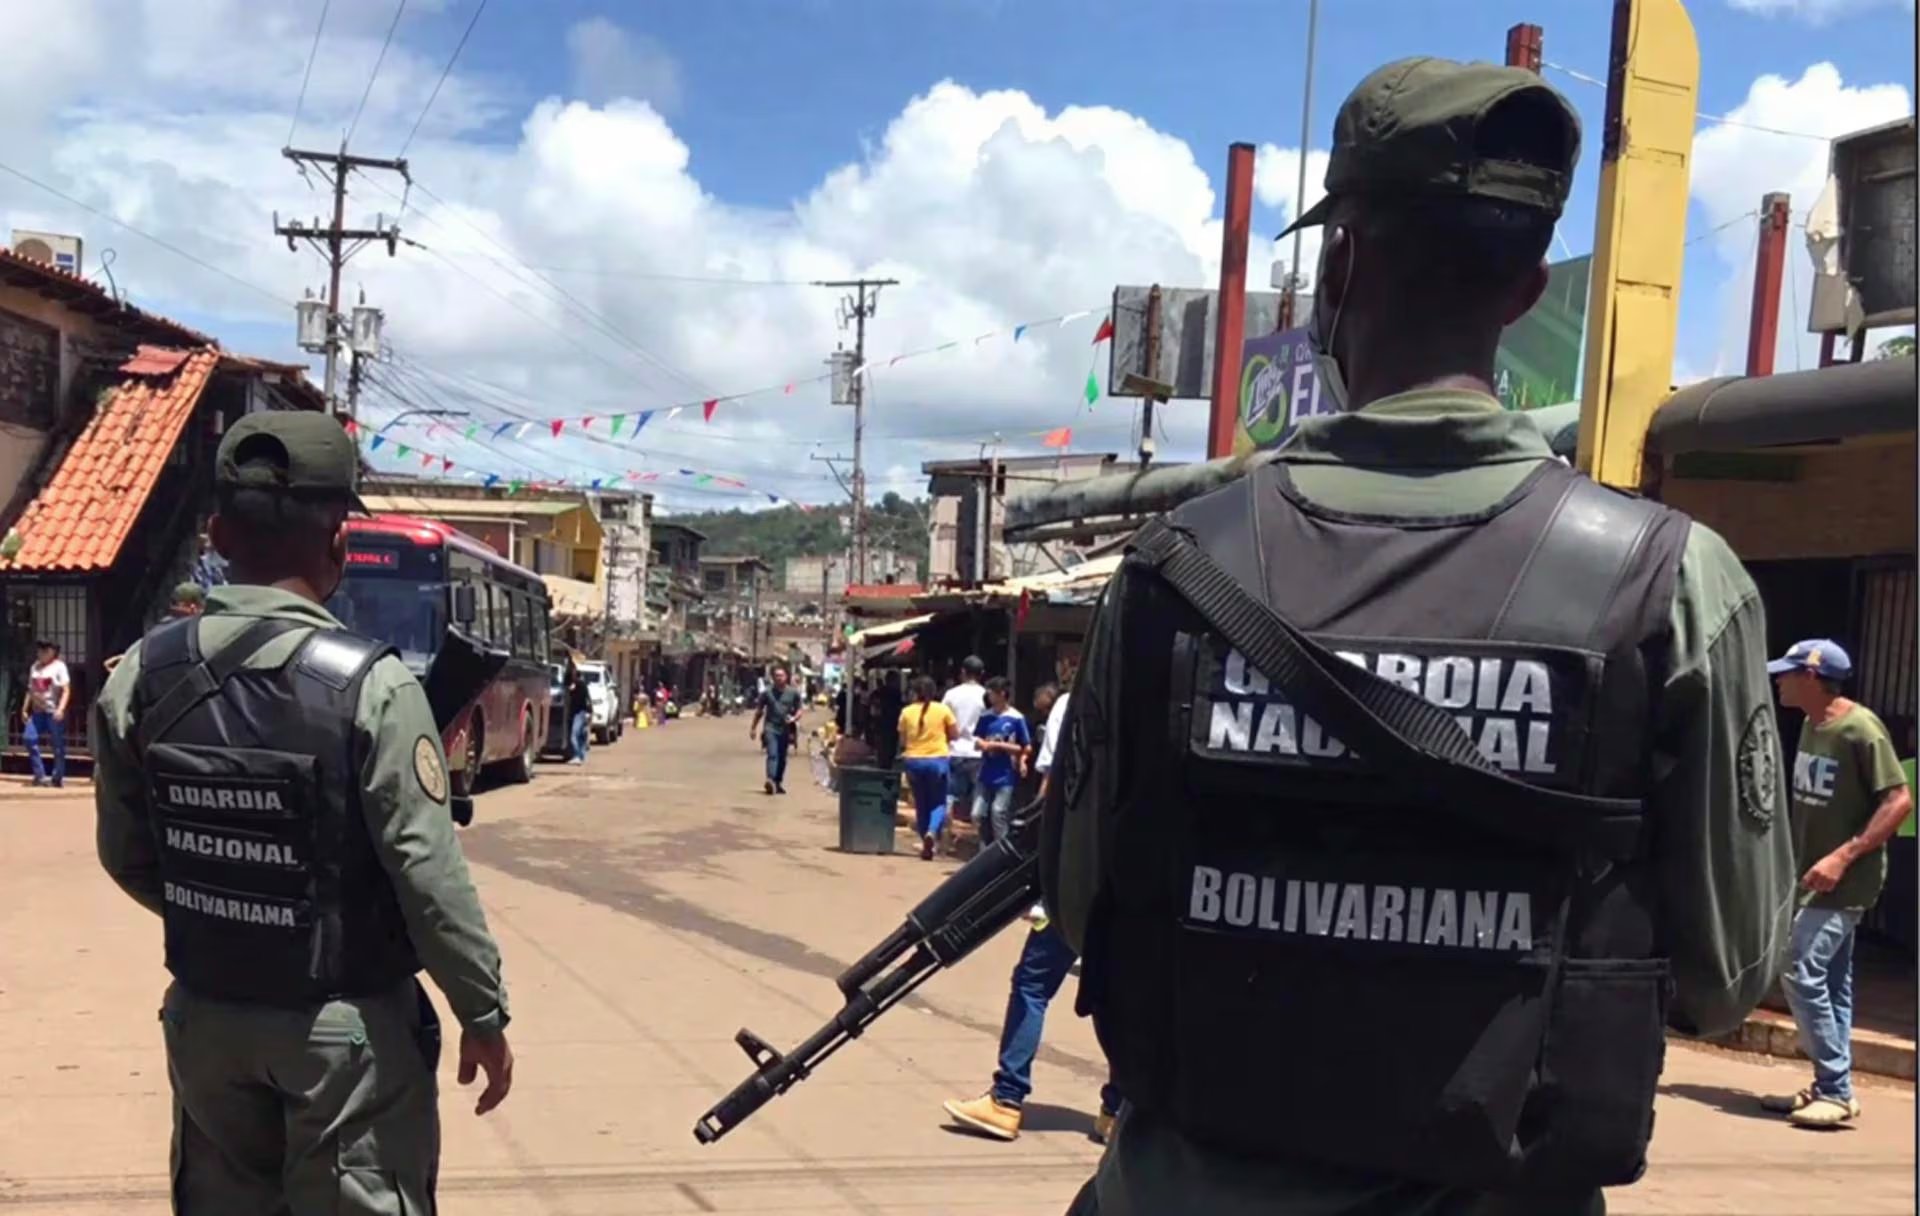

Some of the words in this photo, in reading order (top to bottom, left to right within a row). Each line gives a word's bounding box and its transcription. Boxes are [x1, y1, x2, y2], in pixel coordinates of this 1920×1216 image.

[165, 826, 299, 865] NACIONAL
[163, 880, 296, 928] BOLIVARIANA
[1188, 865, 1533, 951] BOLIVARIANA
